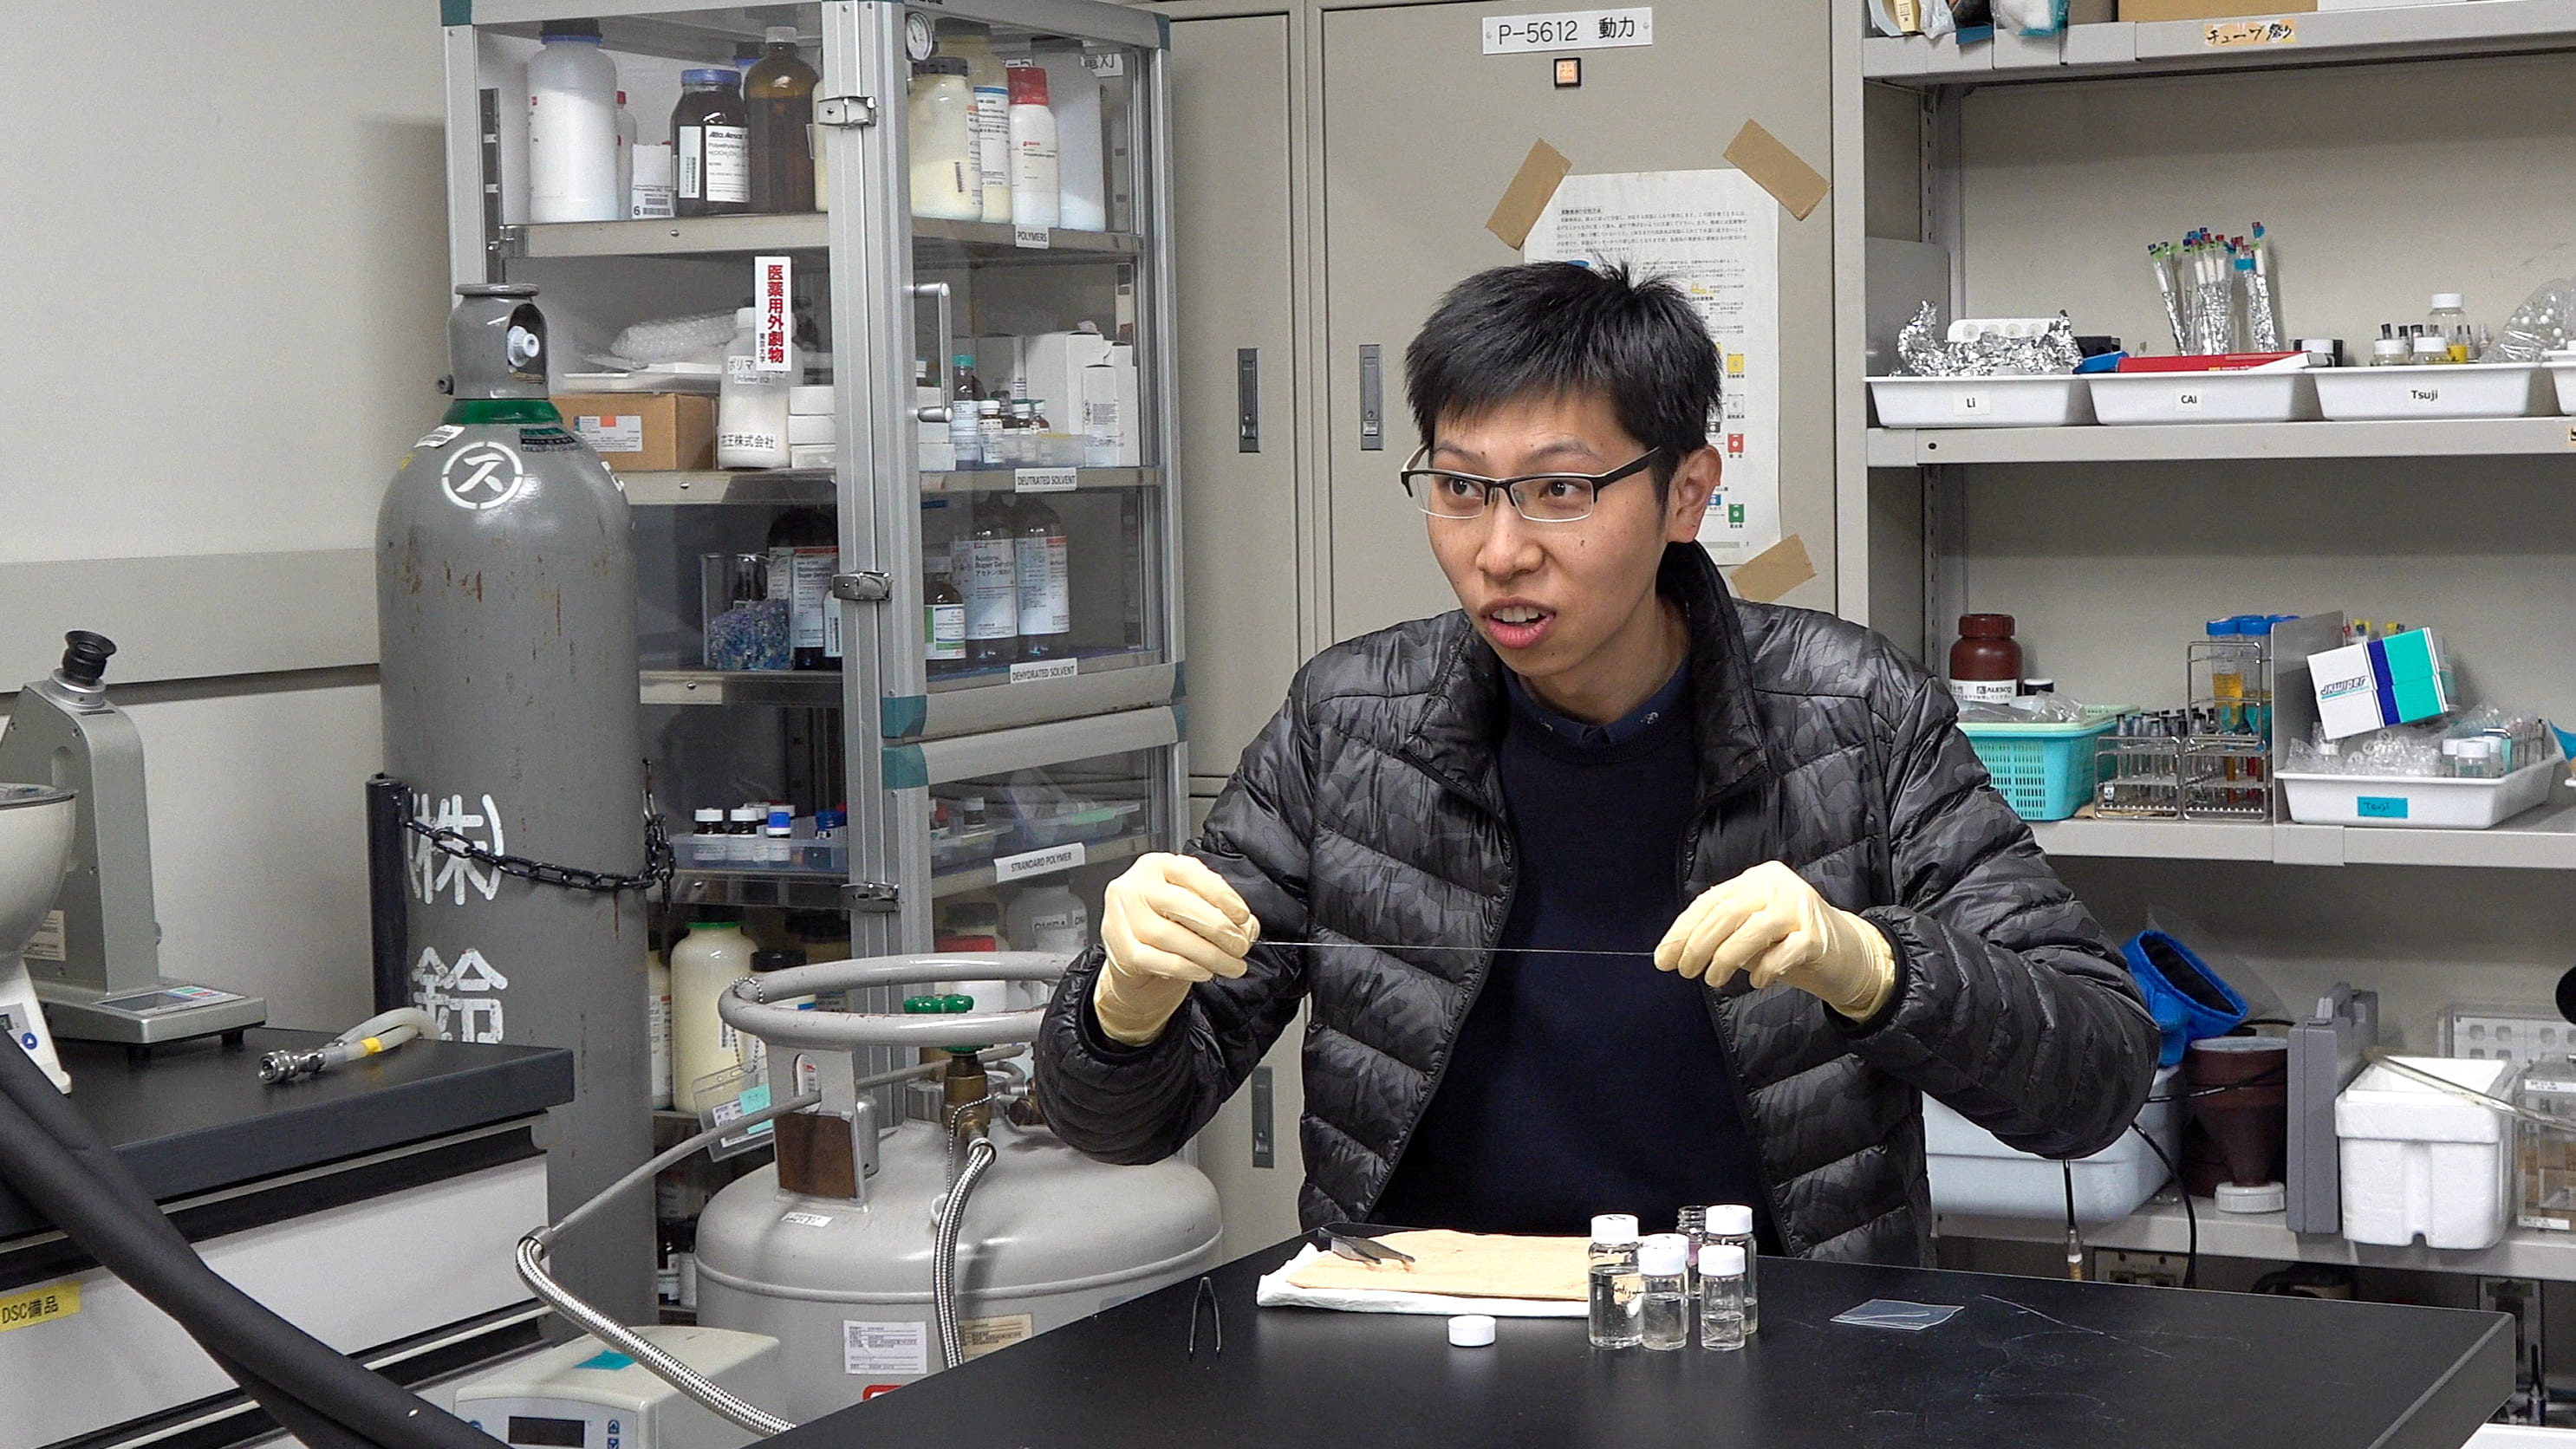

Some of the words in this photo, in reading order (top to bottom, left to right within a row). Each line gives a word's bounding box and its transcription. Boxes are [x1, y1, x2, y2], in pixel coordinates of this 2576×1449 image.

[1499, 20, 1577, 45] P-5612
[1598, 16, 1635, 39] 動力
[634, 205, 641, 216] 6
[1017, 231, 1047, 242] POLYMERS
[768, 264, 784, 363] 医薬用外劇物
[2410, 389, 2438, 401] Tsuji
[1967, 397, 1975, 408] Li
[1051, 475, 1076, 484] SOLVENT
[1012, 668, 1049, 681] DEHYDRATED
[1050, 665, 1075, 677] SOLVENT
[1045, 852, 1072, 866] POLYMER
[2, 1295, 58, 1325] DSC備品
